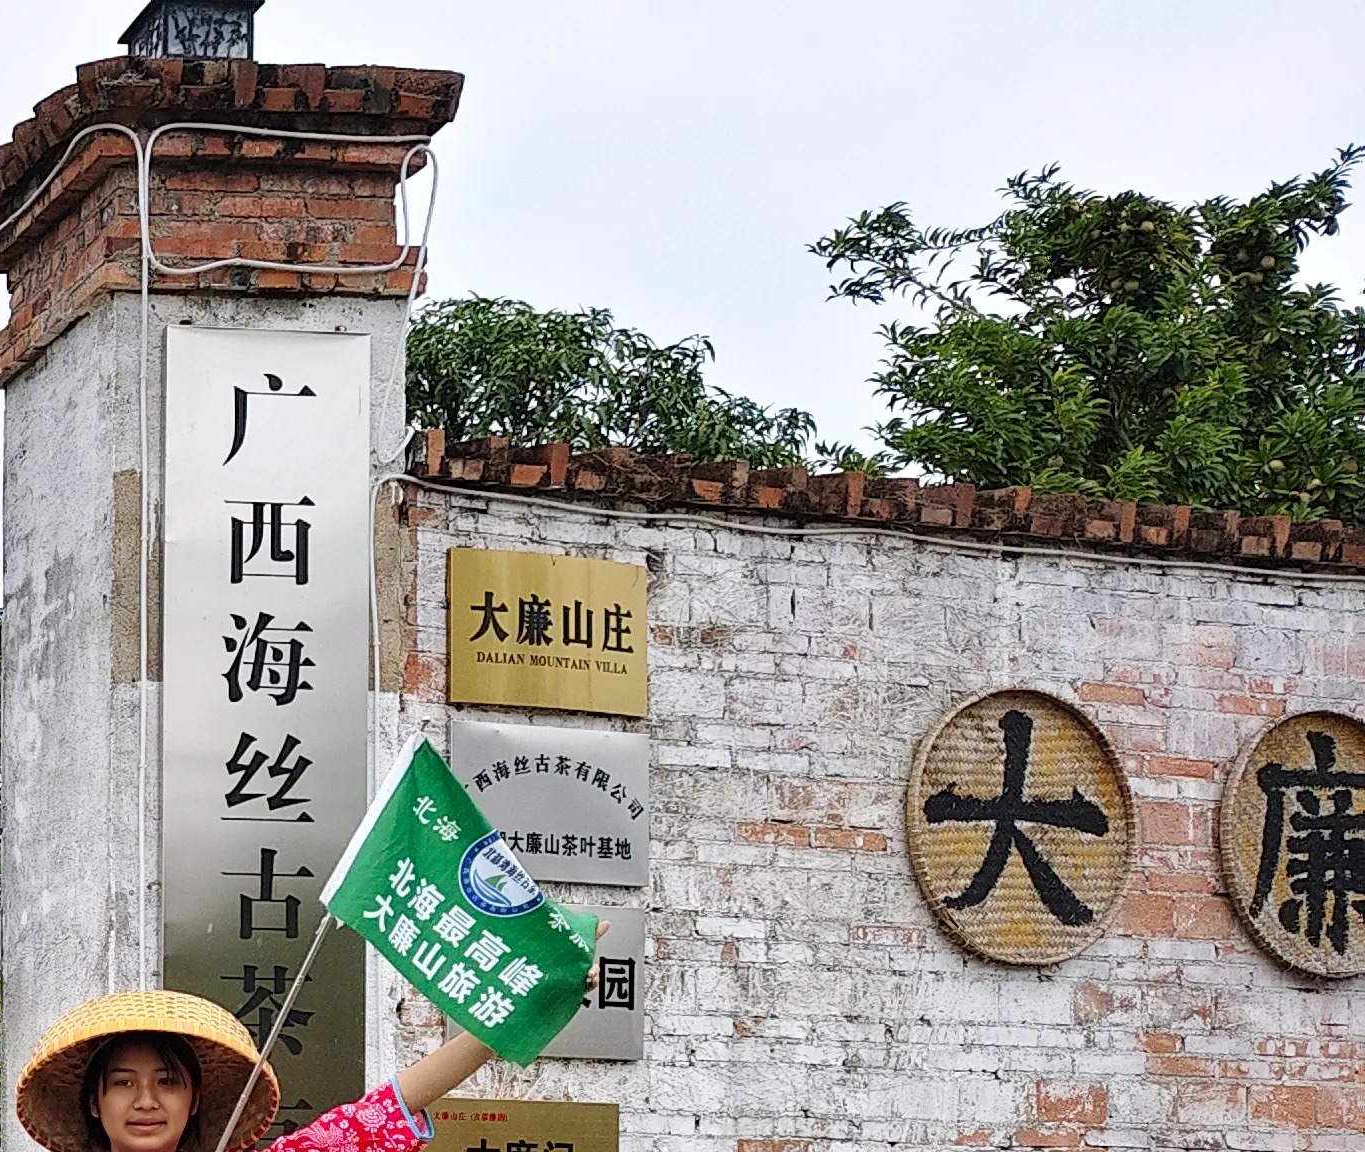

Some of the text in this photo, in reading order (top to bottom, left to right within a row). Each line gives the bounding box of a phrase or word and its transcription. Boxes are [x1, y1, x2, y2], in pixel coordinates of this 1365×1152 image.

[469, 591, 634, 654] 大廉山庄
[477, 651, 628, 675] DALIAN MOUNTAIN VILLA
[413, 796, 462, 842] 北海
[464, 753, 645, 821] 西海丝古茶有限公司
[923, 710, 1109, 926] 大
[363, 893, 516, 1029] 大廉山旅游
[389, 857, 544, 997] 北海最高峰
